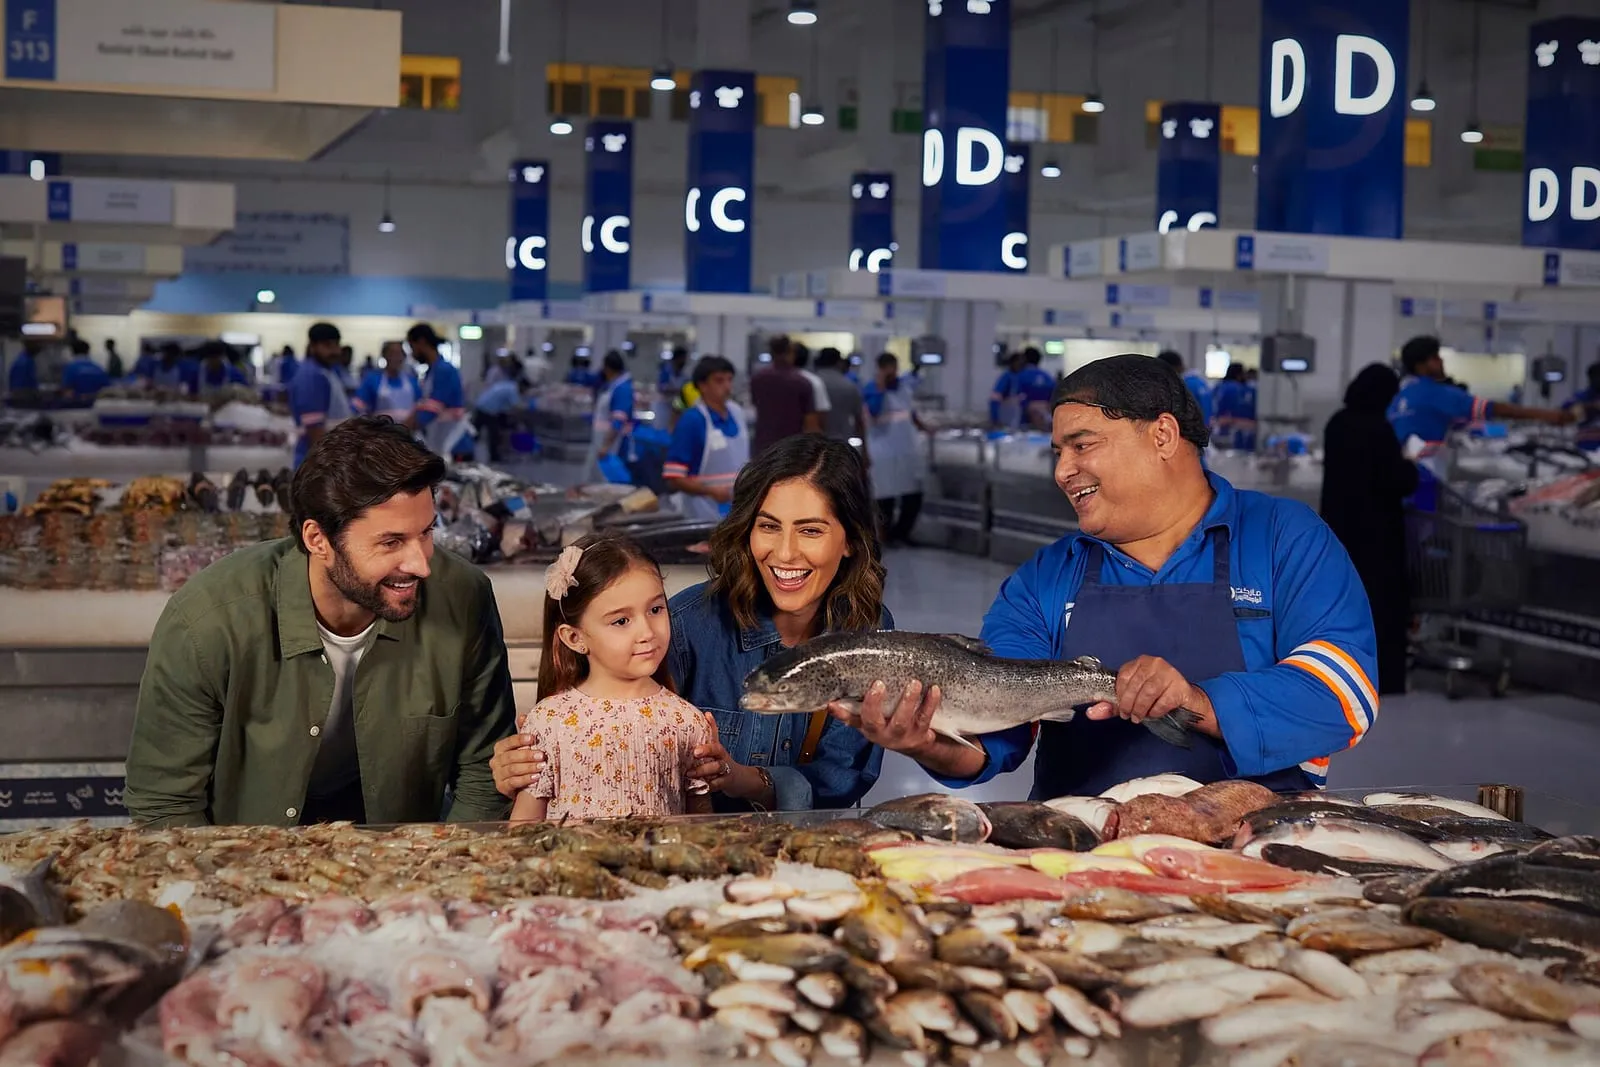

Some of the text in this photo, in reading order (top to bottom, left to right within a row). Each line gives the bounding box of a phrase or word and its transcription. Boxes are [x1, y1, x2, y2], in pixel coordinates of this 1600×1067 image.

[22, 9, 38, 31] F
[10, 40, 50, 62] 313
[1271, 38, 1305, 117] D
[1335, 35, 1395, 115] D
[956, 127, 1004, 186] D
[710, 187, 745, 232] C
[1528, 167, 1559, 221] D
[1570, 166, 1600, 220] D
[518, 235, 546, 270] C
[600, 215, 630, 253] C
[1001, 232, 1027, 269] C
